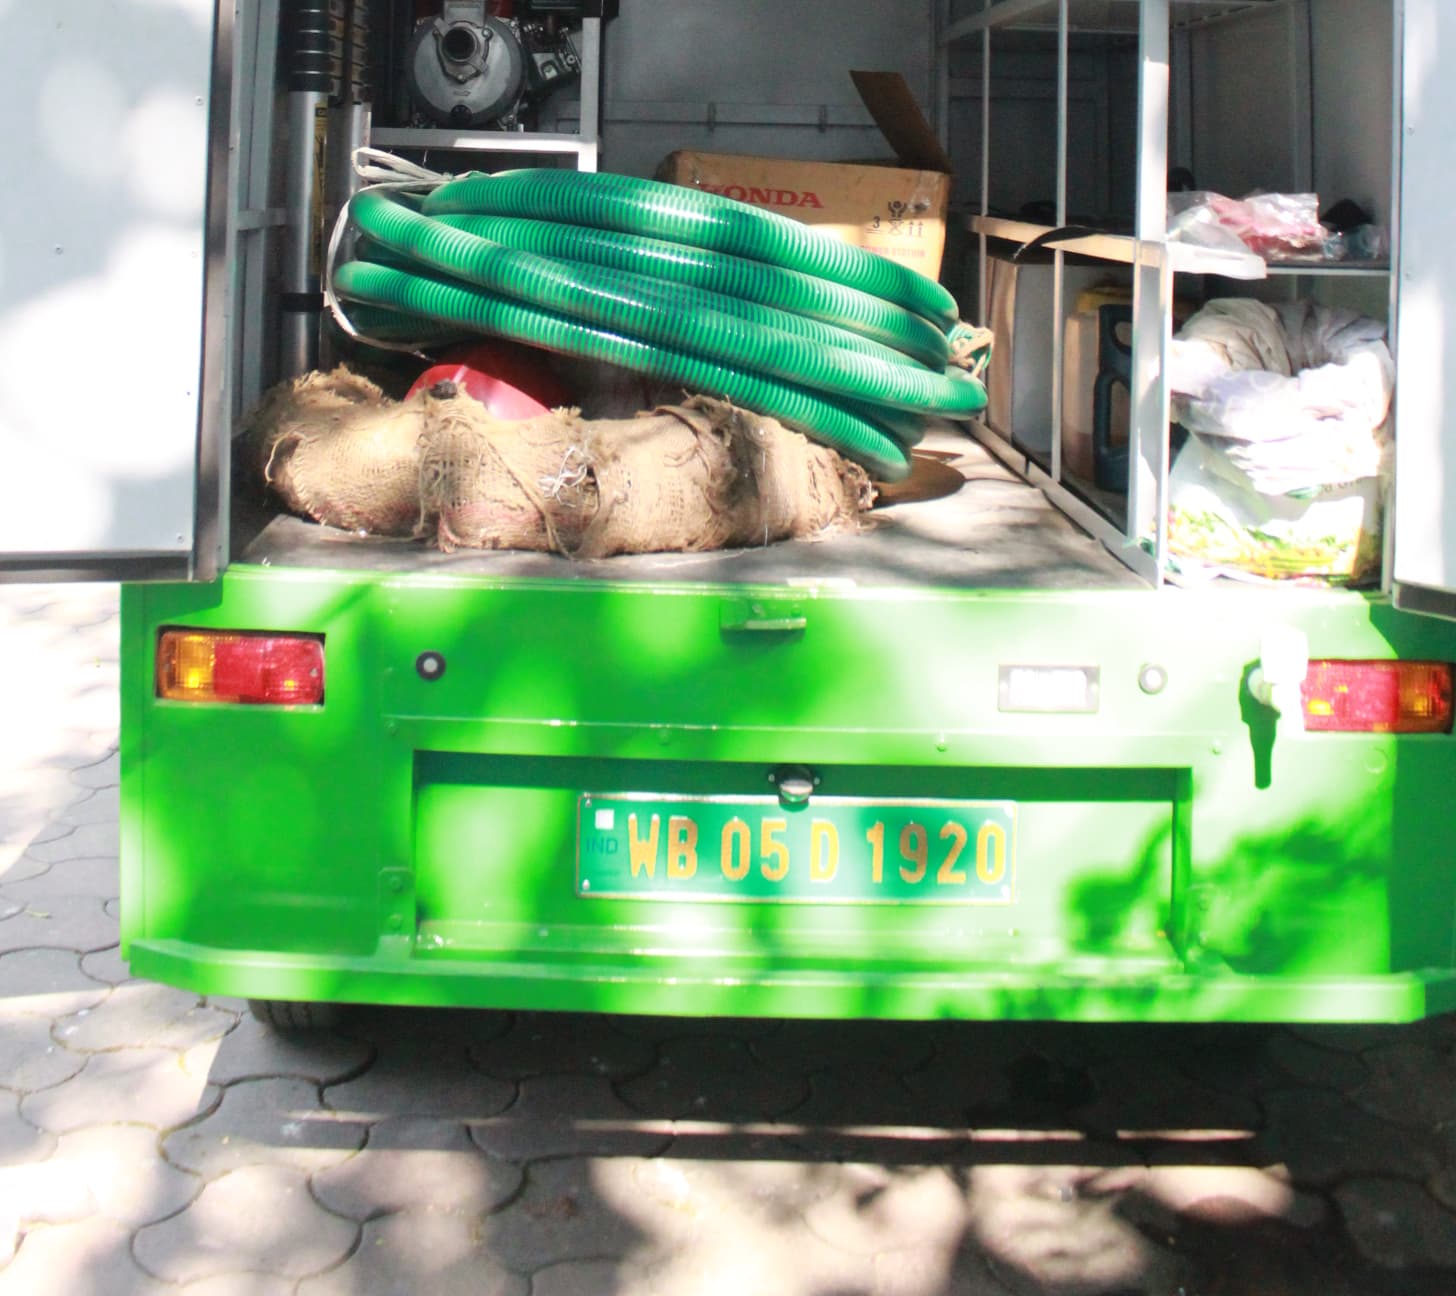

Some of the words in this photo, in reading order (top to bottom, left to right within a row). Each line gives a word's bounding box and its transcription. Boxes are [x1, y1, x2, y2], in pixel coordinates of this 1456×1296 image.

[585, 837, 618, 855] IND
[628, 812, 698, 879] WB
[720, 816, 790, 882] 05
[810, 818, 840, 883] D
[866, 819, 1006, 885] 1920
